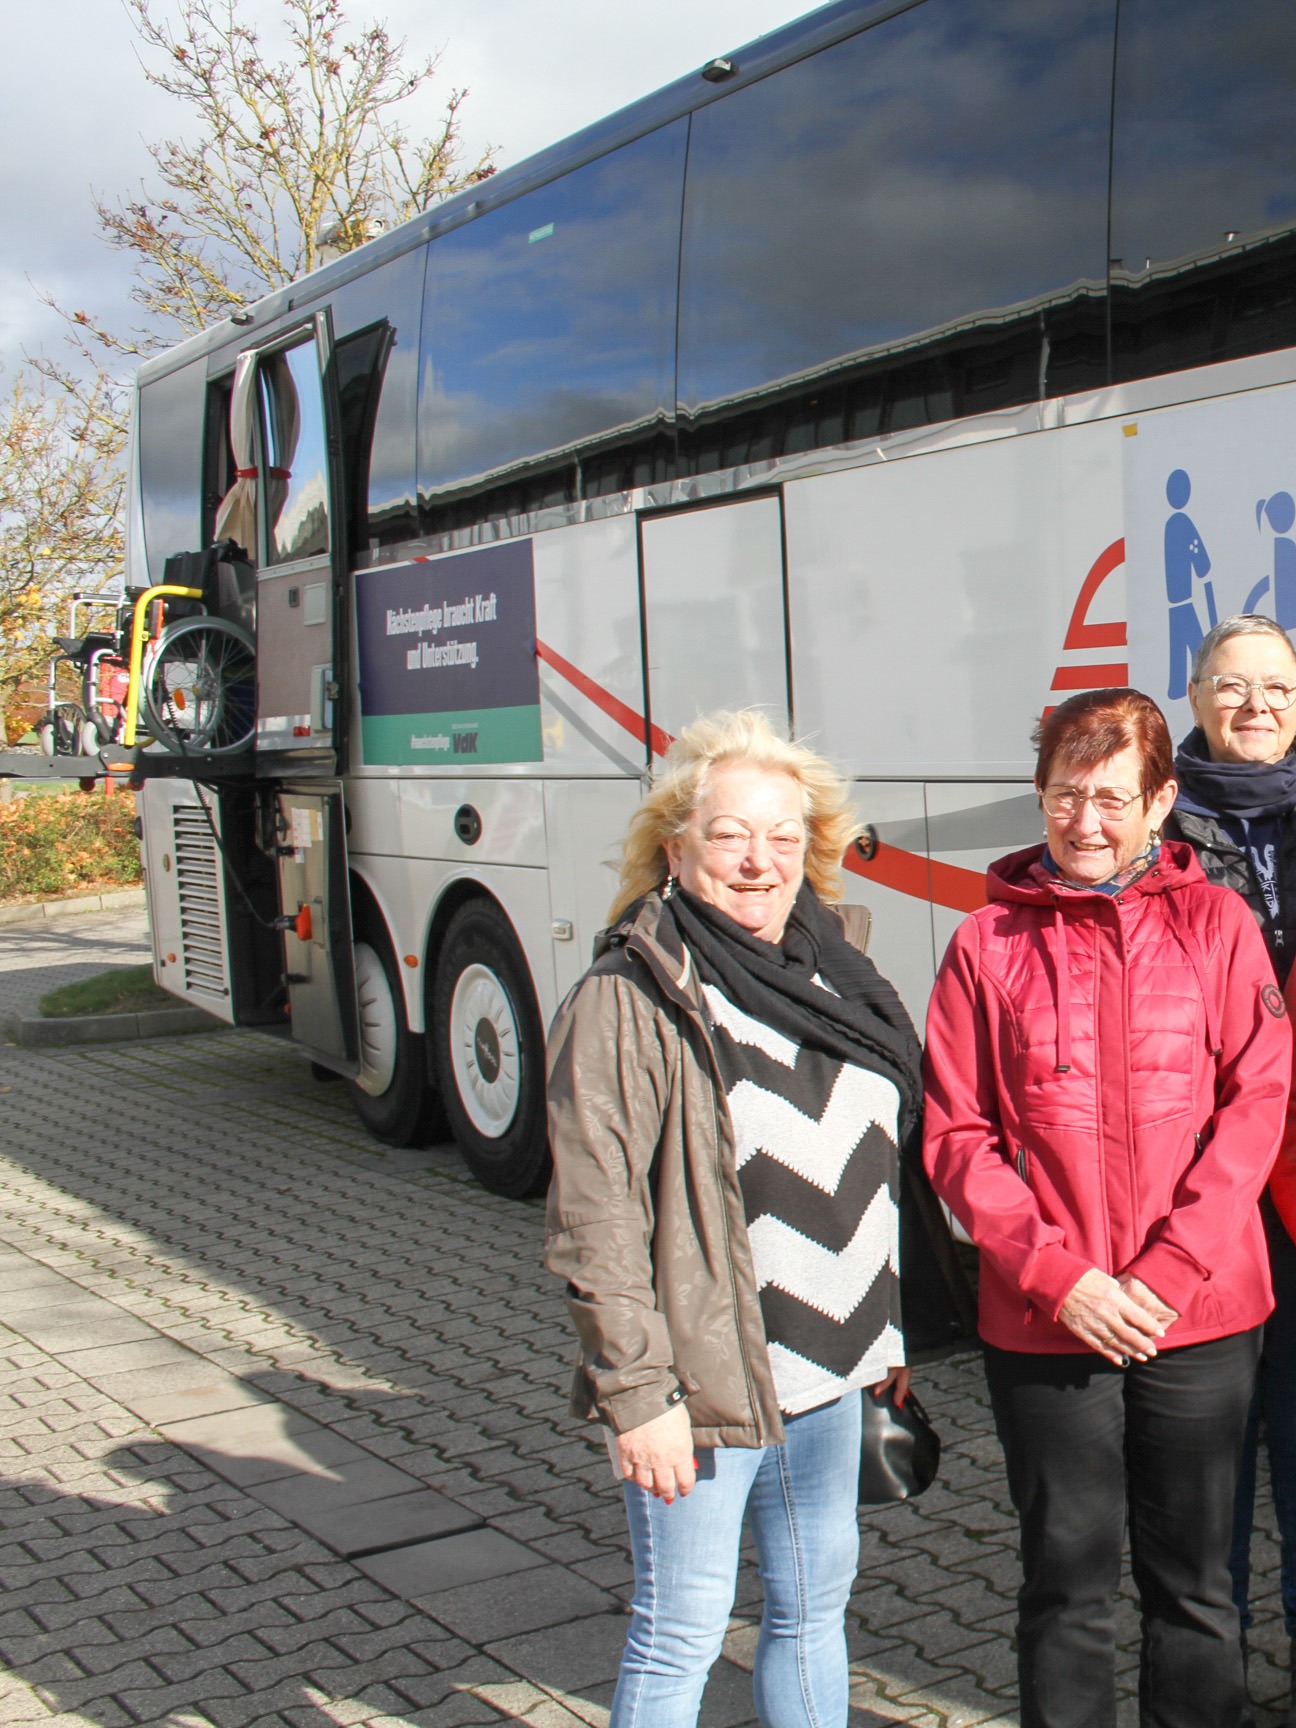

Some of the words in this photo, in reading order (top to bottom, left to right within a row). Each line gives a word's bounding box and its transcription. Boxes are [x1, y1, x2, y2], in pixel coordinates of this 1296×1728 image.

[443, 597, 475, 628] braucht
[475, 592, 497, 623] Kraft
[407, 642, 421, 670] und
[453, 732, 478, 753] VdK
